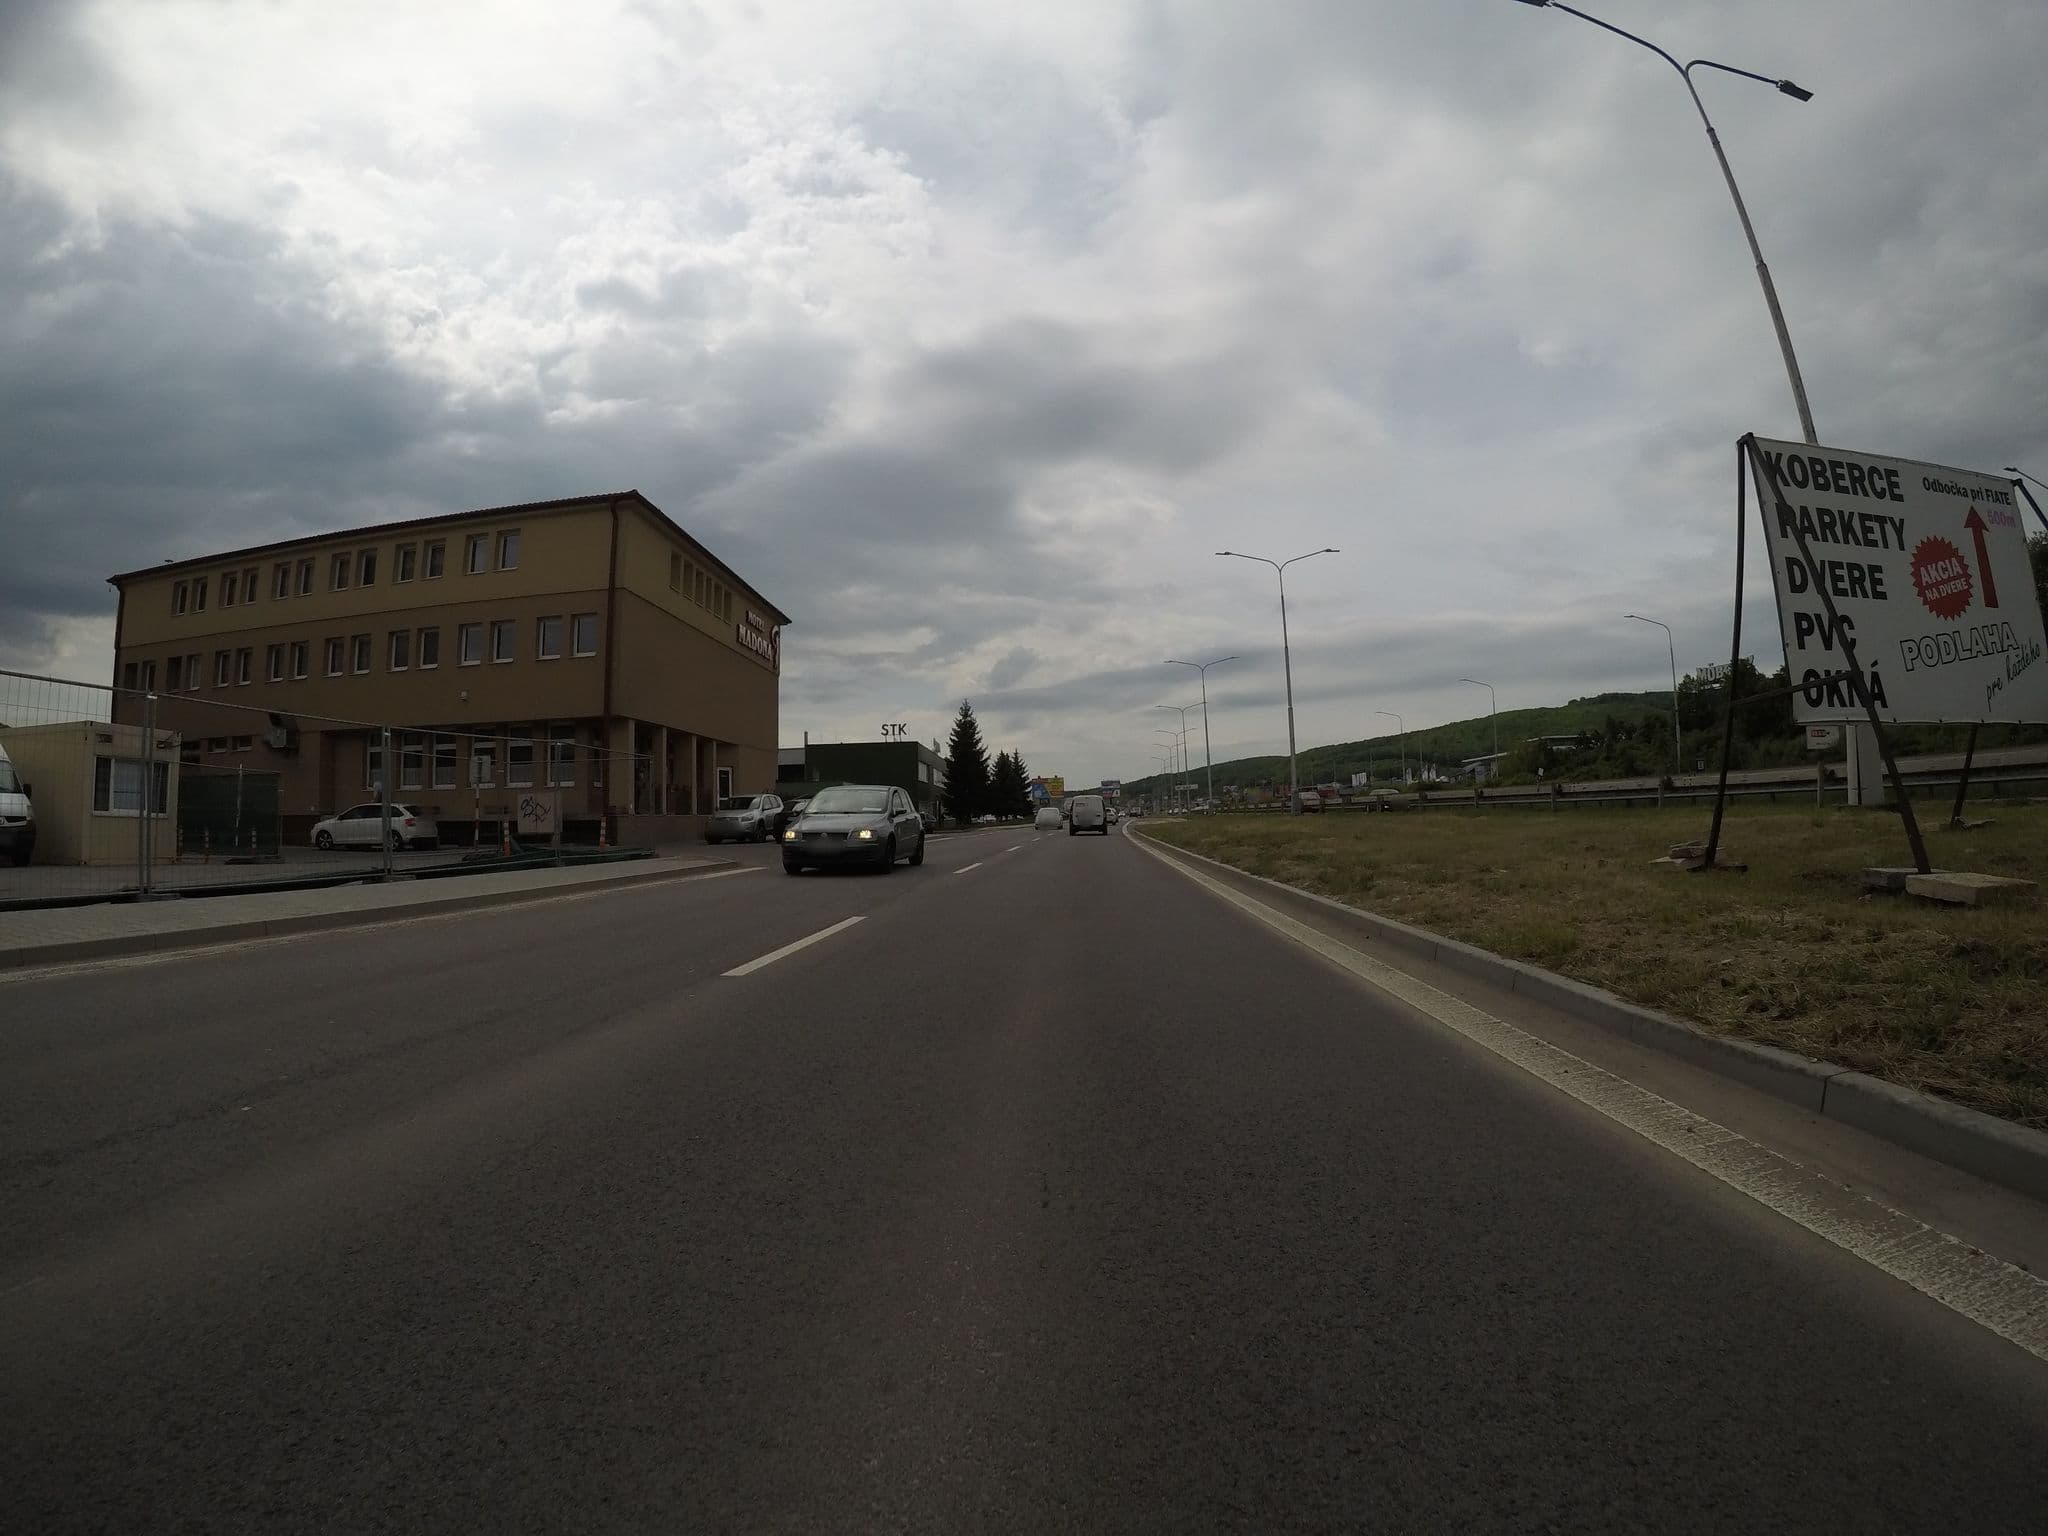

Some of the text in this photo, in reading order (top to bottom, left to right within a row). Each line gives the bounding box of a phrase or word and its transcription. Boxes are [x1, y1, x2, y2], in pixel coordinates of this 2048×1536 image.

[1764, 450, 1904, 503] KOBERCE
[1922, 477, 2011, 506] Odbočka pri FIATE
[1775, 503, 1905, 551] PARKETY
[1785, 557, 1888, 600] DVERE
[1920, 557, 1963, 586] AKCIA
[1925, 577, 1969, 601] NA DVERE
[1794, 612, 1856, 650] PVC
[1900, 621, 2019, 672] PODLAHA
[1802, 660, 1888, 708] OKNÁ
[1986, 676, 2002, 712] pre
[881, 723, 907, 736] STK
